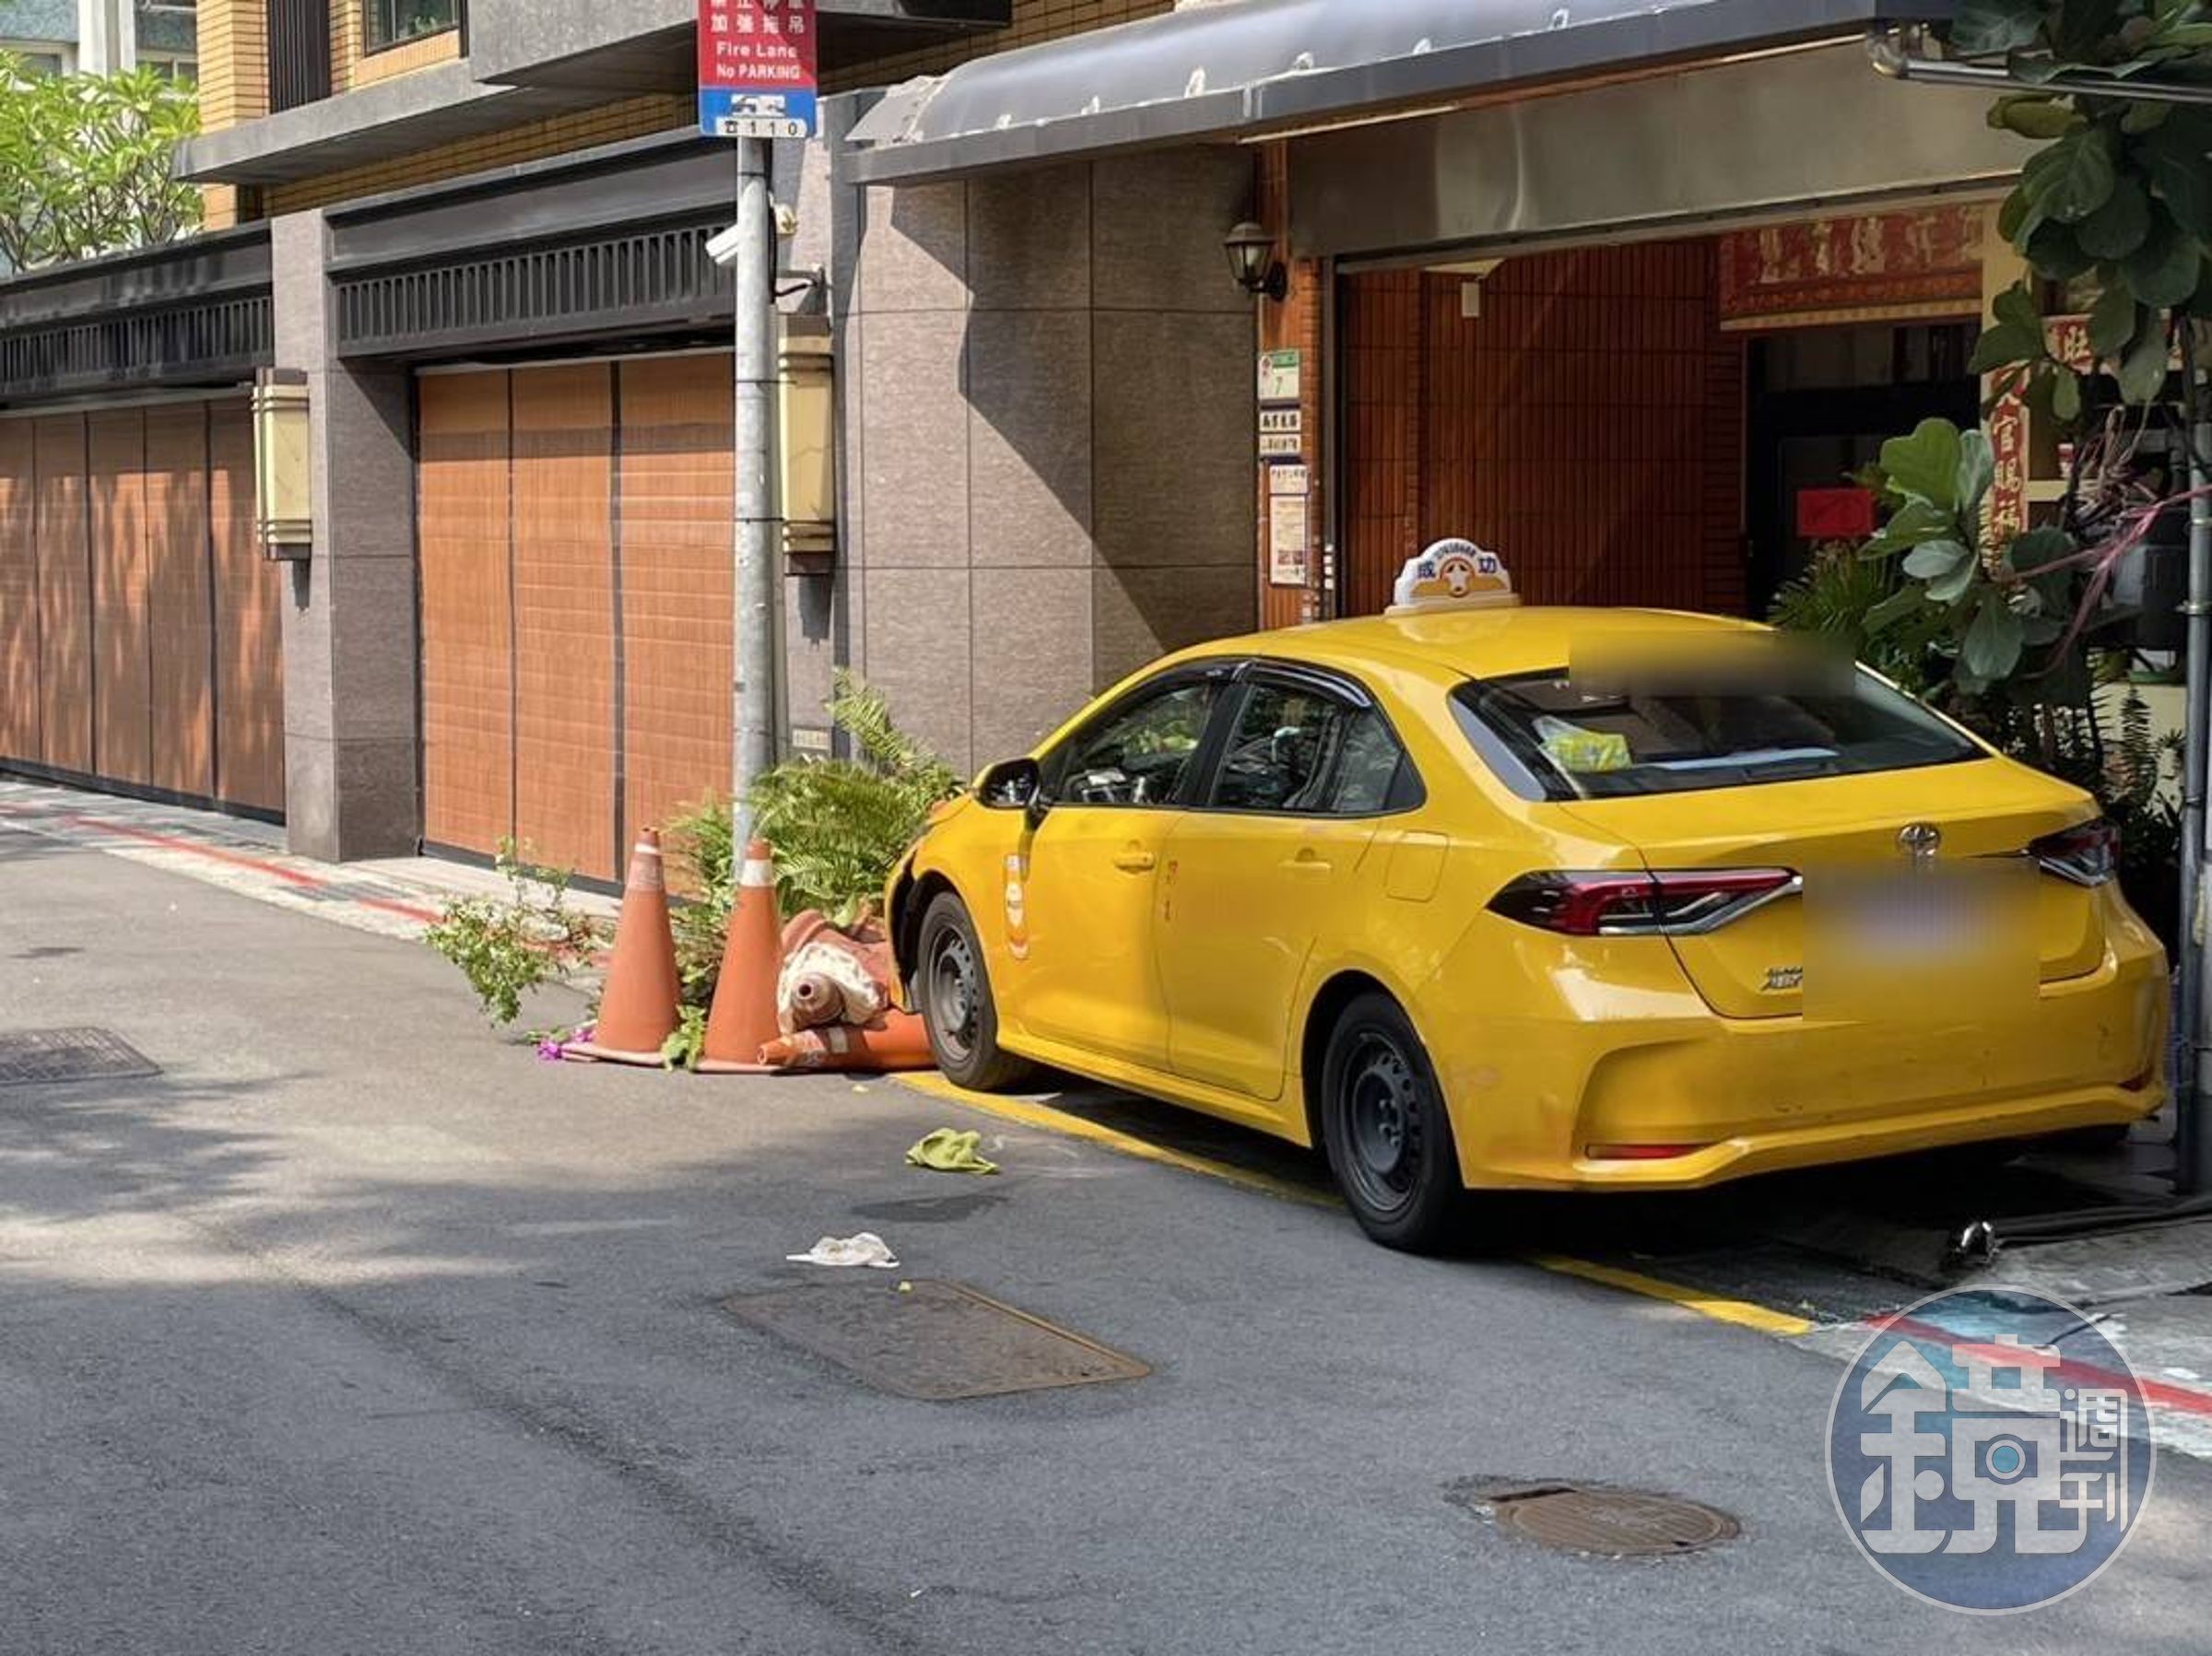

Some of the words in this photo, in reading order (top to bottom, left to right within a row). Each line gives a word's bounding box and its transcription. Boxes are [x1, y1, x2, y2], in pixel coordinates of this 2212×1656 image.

[716, 41, 750, 56] Fire
[757, 42, 798, 58] Lane
[716, 64, 735, 78] No
[738, 64, 802, 80] PARKING
